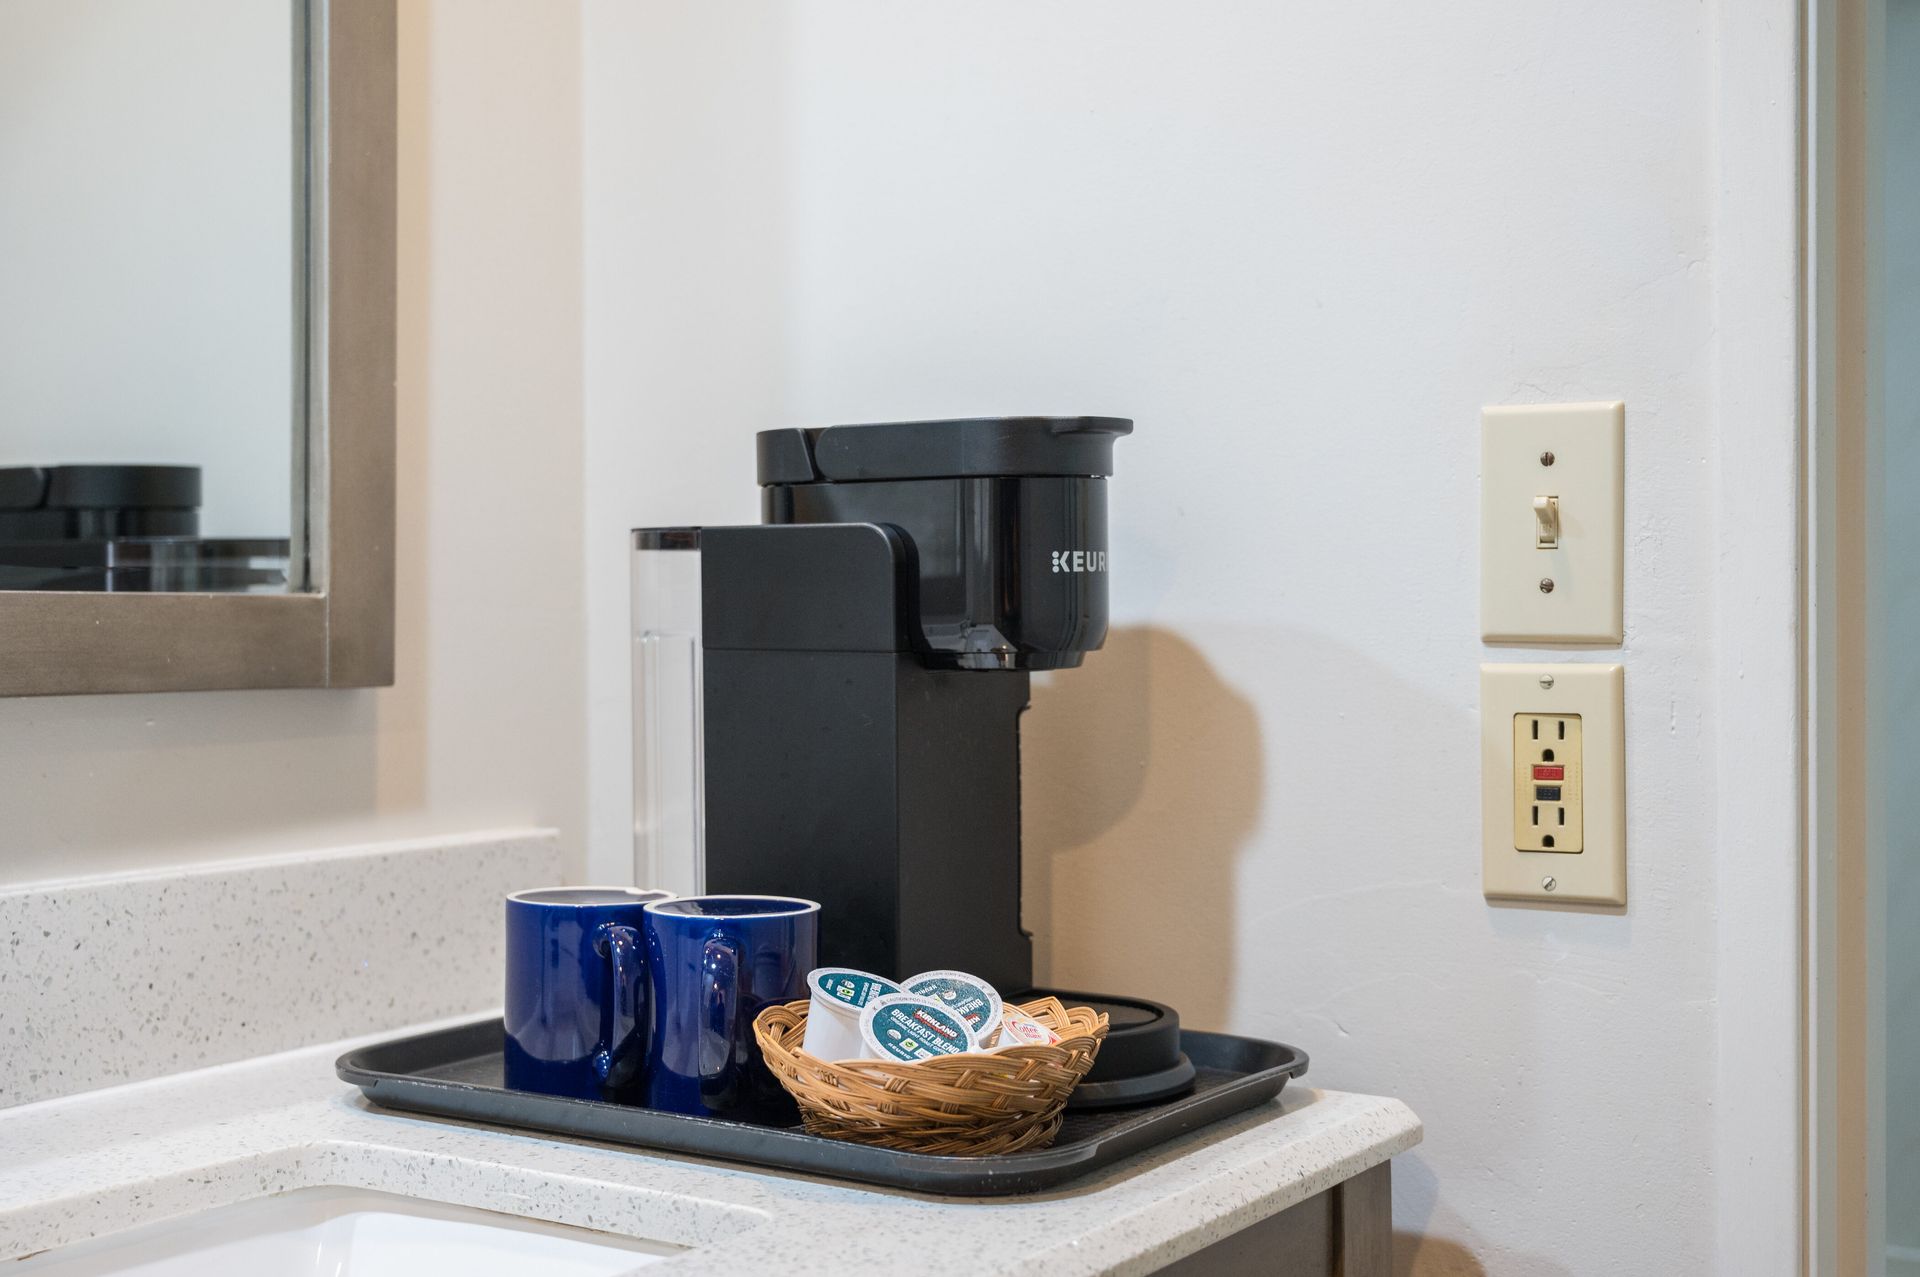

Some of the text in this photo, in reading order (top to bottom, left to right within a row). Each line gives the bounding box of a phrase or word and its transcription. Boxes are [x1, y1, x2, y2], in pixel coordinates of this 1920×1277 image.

[1052, 551, 1109, 573] KEUR
[956, 998, 983, 1015] BREAK
[891, 1008, 936, 1041] BREAKFAST
[932, 1037, 960, 1054] BLEND
[915, 1009, 958, 1038] KIRKLAND
